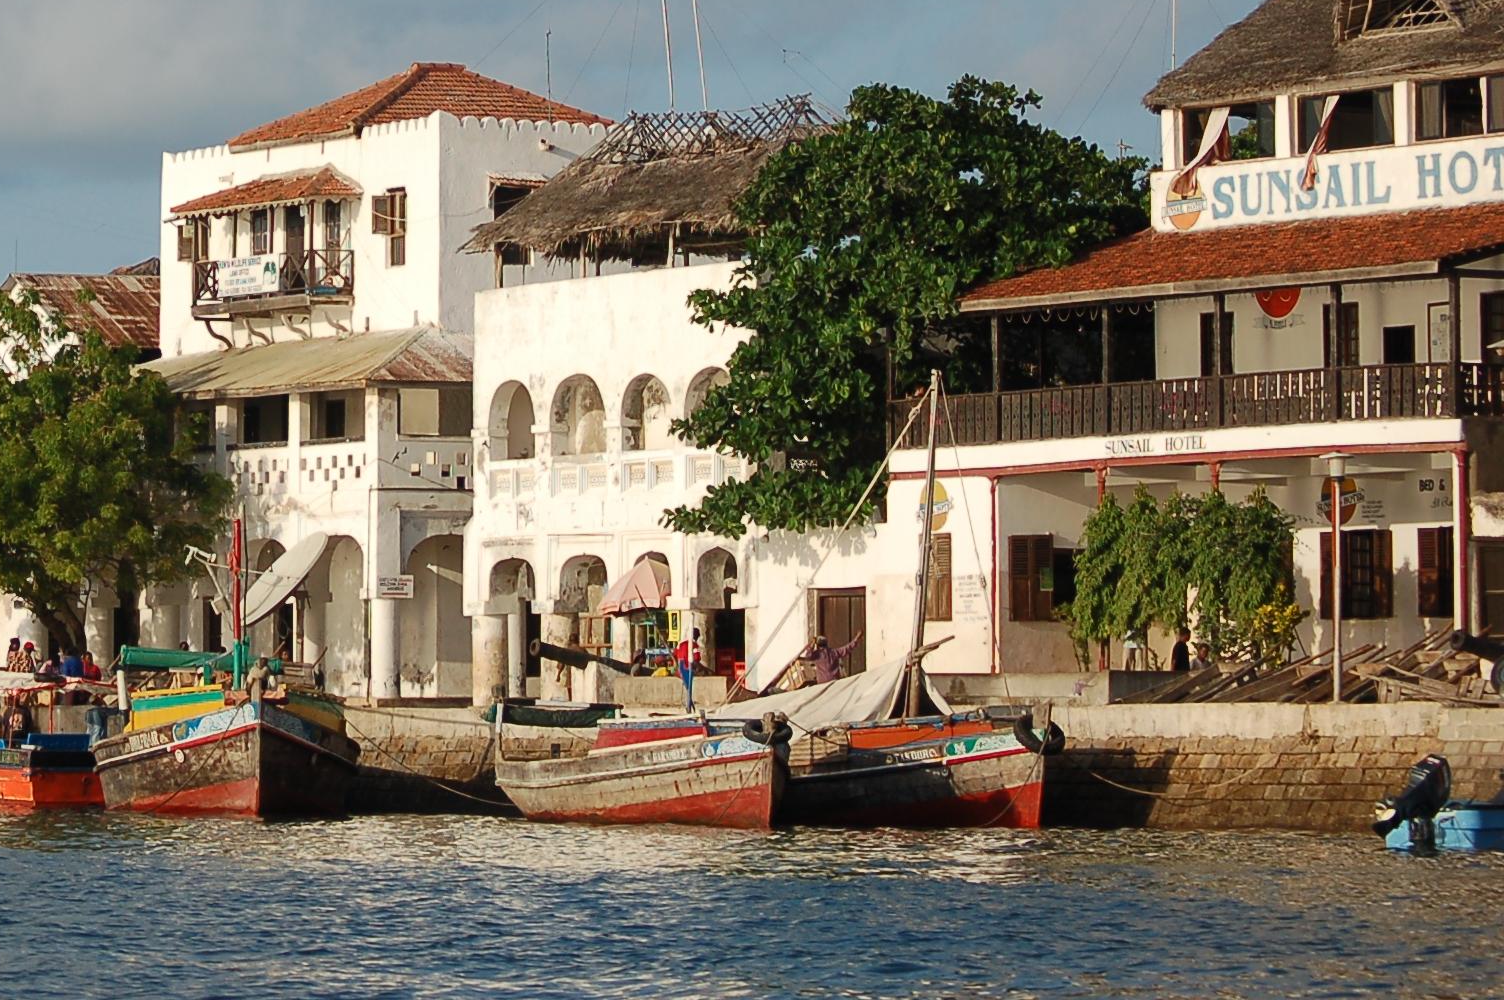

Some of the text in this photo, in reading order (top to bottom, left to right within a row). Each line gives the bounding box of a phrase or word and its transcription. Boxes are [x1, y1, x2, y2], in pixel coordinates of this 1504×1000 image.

[1212, 161, 1391, 220] SUNSAIL
[1104, 434, 1206, 455] SUNSAIL HOTEL
[1418, 479, 1435, 492] BED
